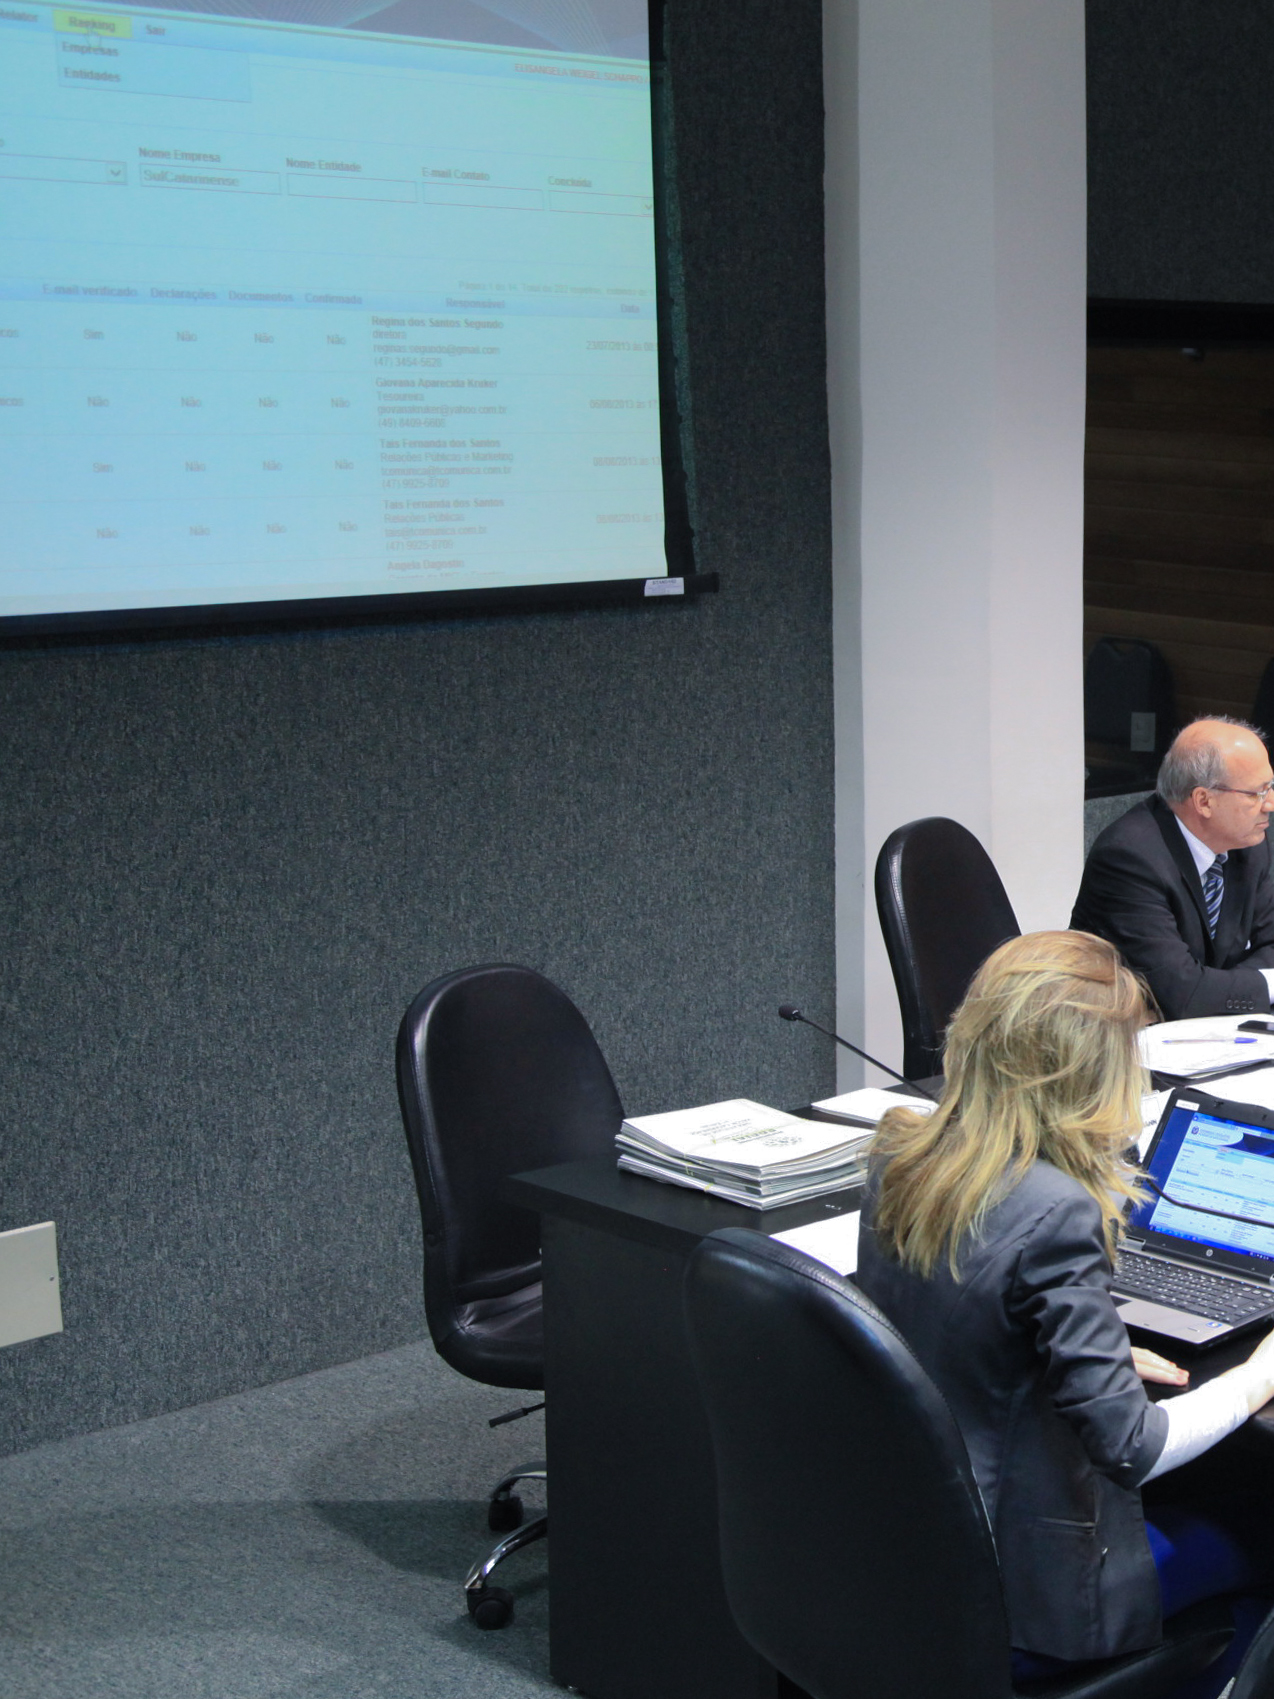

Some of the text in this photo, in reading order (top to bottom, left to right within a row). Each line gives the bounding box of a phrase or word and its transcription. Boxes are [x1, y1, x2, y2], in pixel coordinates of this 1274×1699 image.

[68, 16, 117, 33] Ranking
[145, 24, 167, 36] Sair
[61, 41, 120, 58] Empresas
[63, 67, 122, 83] Entidades
[138, 147, 222, 164] Nome Empresa
[286, 157, 363, 173] Nome Entidade
[81, 285, 139, 298] verificado
[150, 286, 218, 302] Declarações
[228, 290, 295, 303] Documentos
[445, 297, 506, 310] Responsável
[371, 315, 505, 330] Regina dos Santos Segundo
[176, 330, 198, 343] Não
[254, 332, 275, 345] Não
[326, 333, 347, 346] Não
[375, 376, 416, 388] Giovana
[87, 396, 111, 409] Não
[181, 396, 203, 409] Não
[258, 396, 279, 409] Não
[331, 396, 351, 409] Não
[449, 437, 467, 448] dos
[470, 437, 502, 448] Santos
[185, 459, 207, 473] Não
[262, 459, 283, 472] Não
[334, 458, 355, 471] Não
[453, 498, 471, 509] dos
[474, 497, 505, 508] Santos
[97, 526, 119, 540] Não
[189, 525, 211, 538] Não
[266, 522, 287, 536] Não
[338, 520, 359, 533] Não
